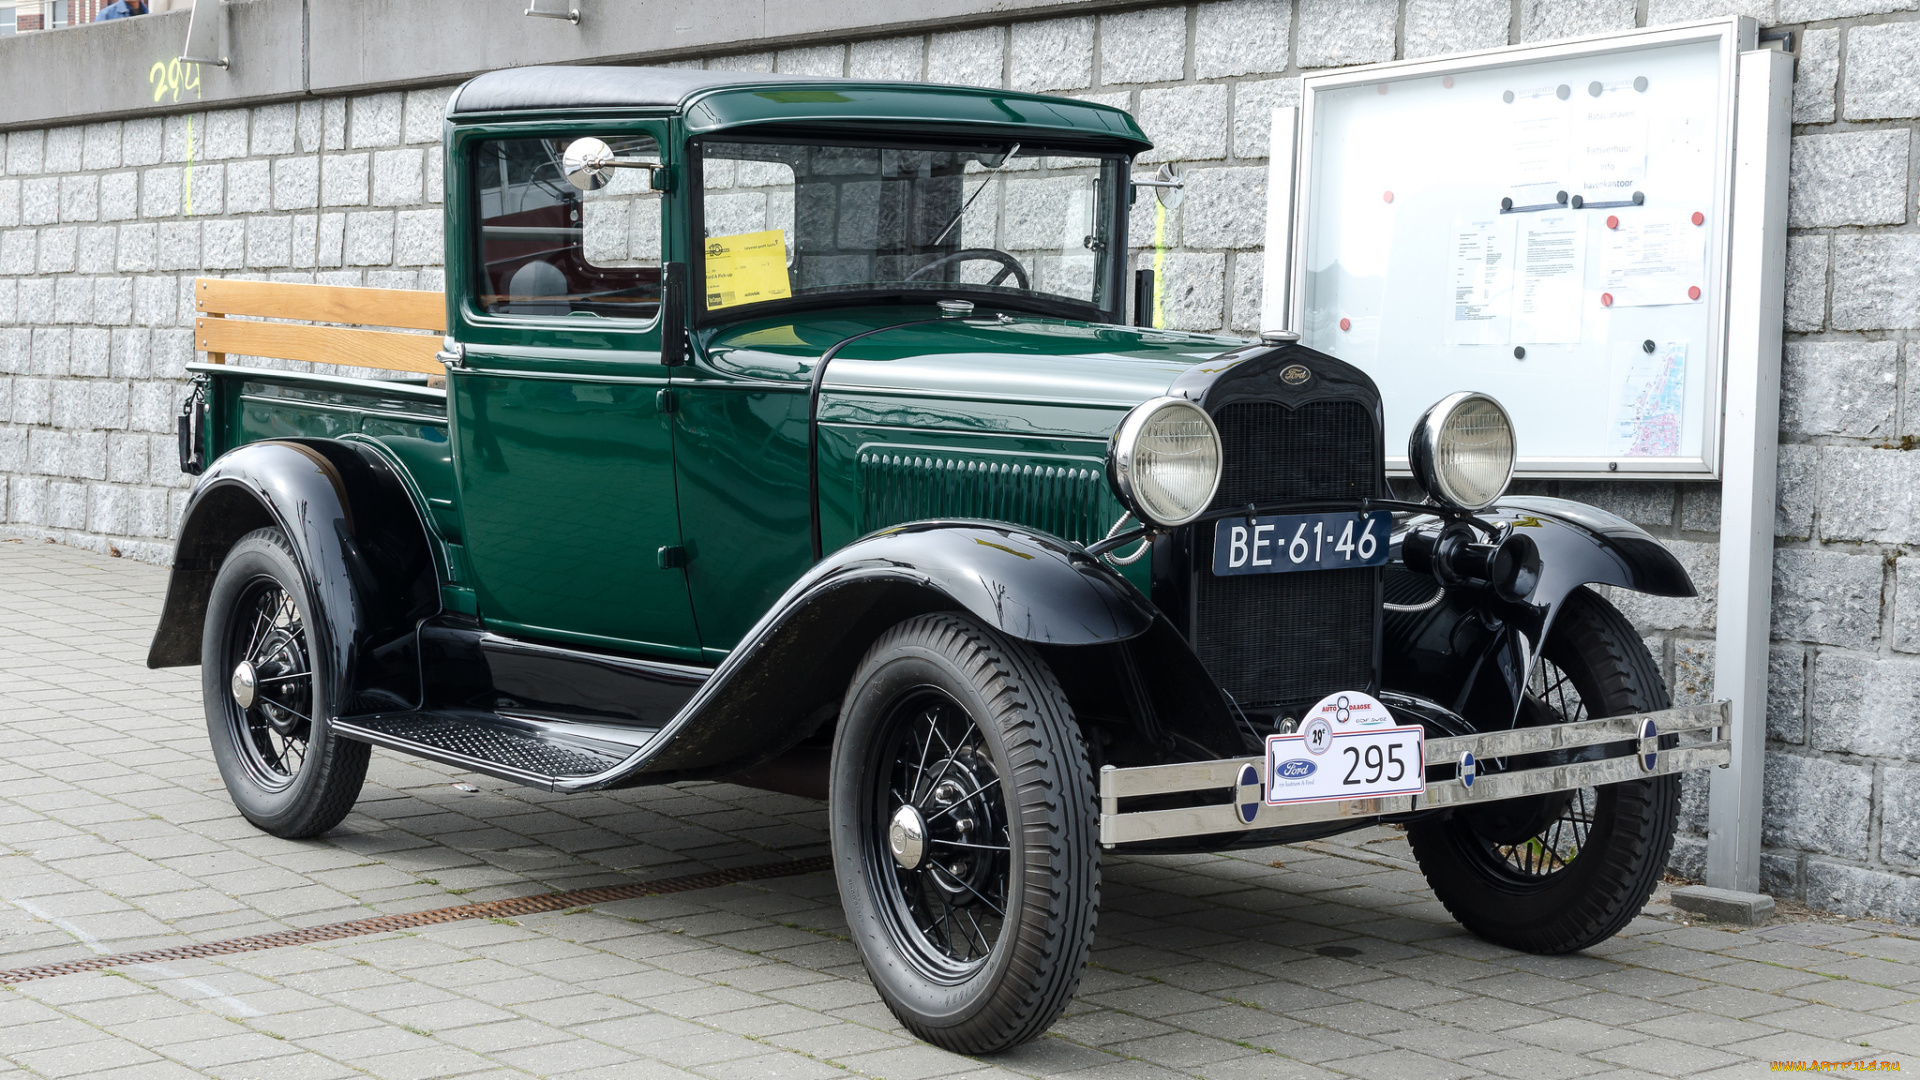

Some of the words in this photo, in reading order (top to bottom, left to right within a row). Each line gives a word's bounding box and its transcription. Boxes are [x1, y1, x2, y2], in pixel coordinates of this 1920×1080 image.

[149, 57, 201, 103] 294
[1583, 180, 1634, 189] havenkantoor
[1285, 368, 1307, 381] Ford
[1229, 519, 1377, 568] BE-61-46
[1284, 762, 1309, 776] Ford
[1342, 743, 1405, 785] 295
